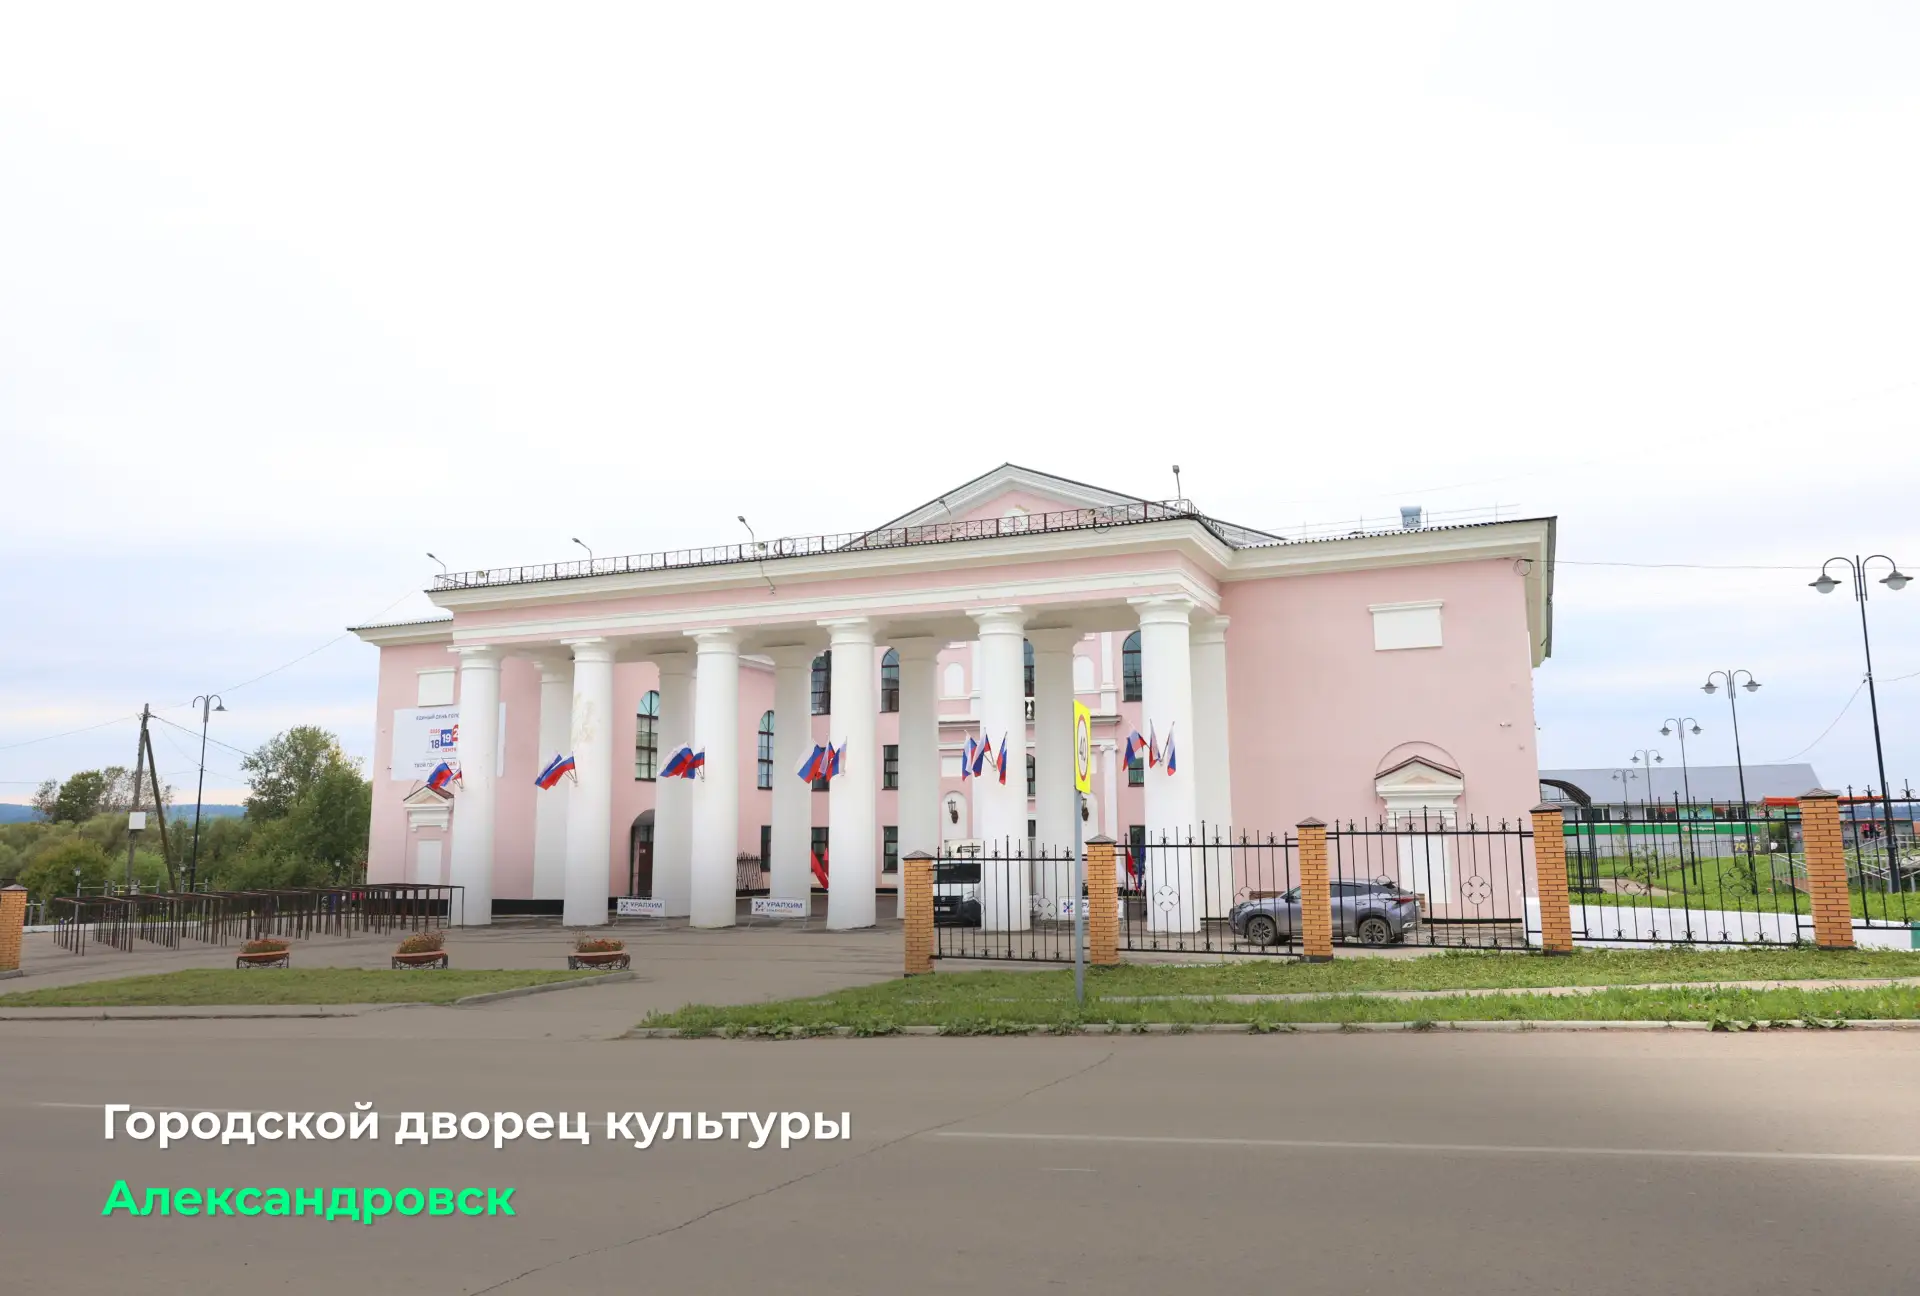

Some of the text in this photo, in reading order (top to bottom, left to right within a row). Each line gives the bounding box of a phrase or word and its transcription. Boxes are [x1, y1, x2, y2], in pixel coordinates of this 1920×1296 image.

[430, 739, 440, 749] 18
[441, 733, 451, 744] 19
[630, 901, 663, 909] УРАЛХИМ
[766, 901, 803, 909] УРАЛХИМ
